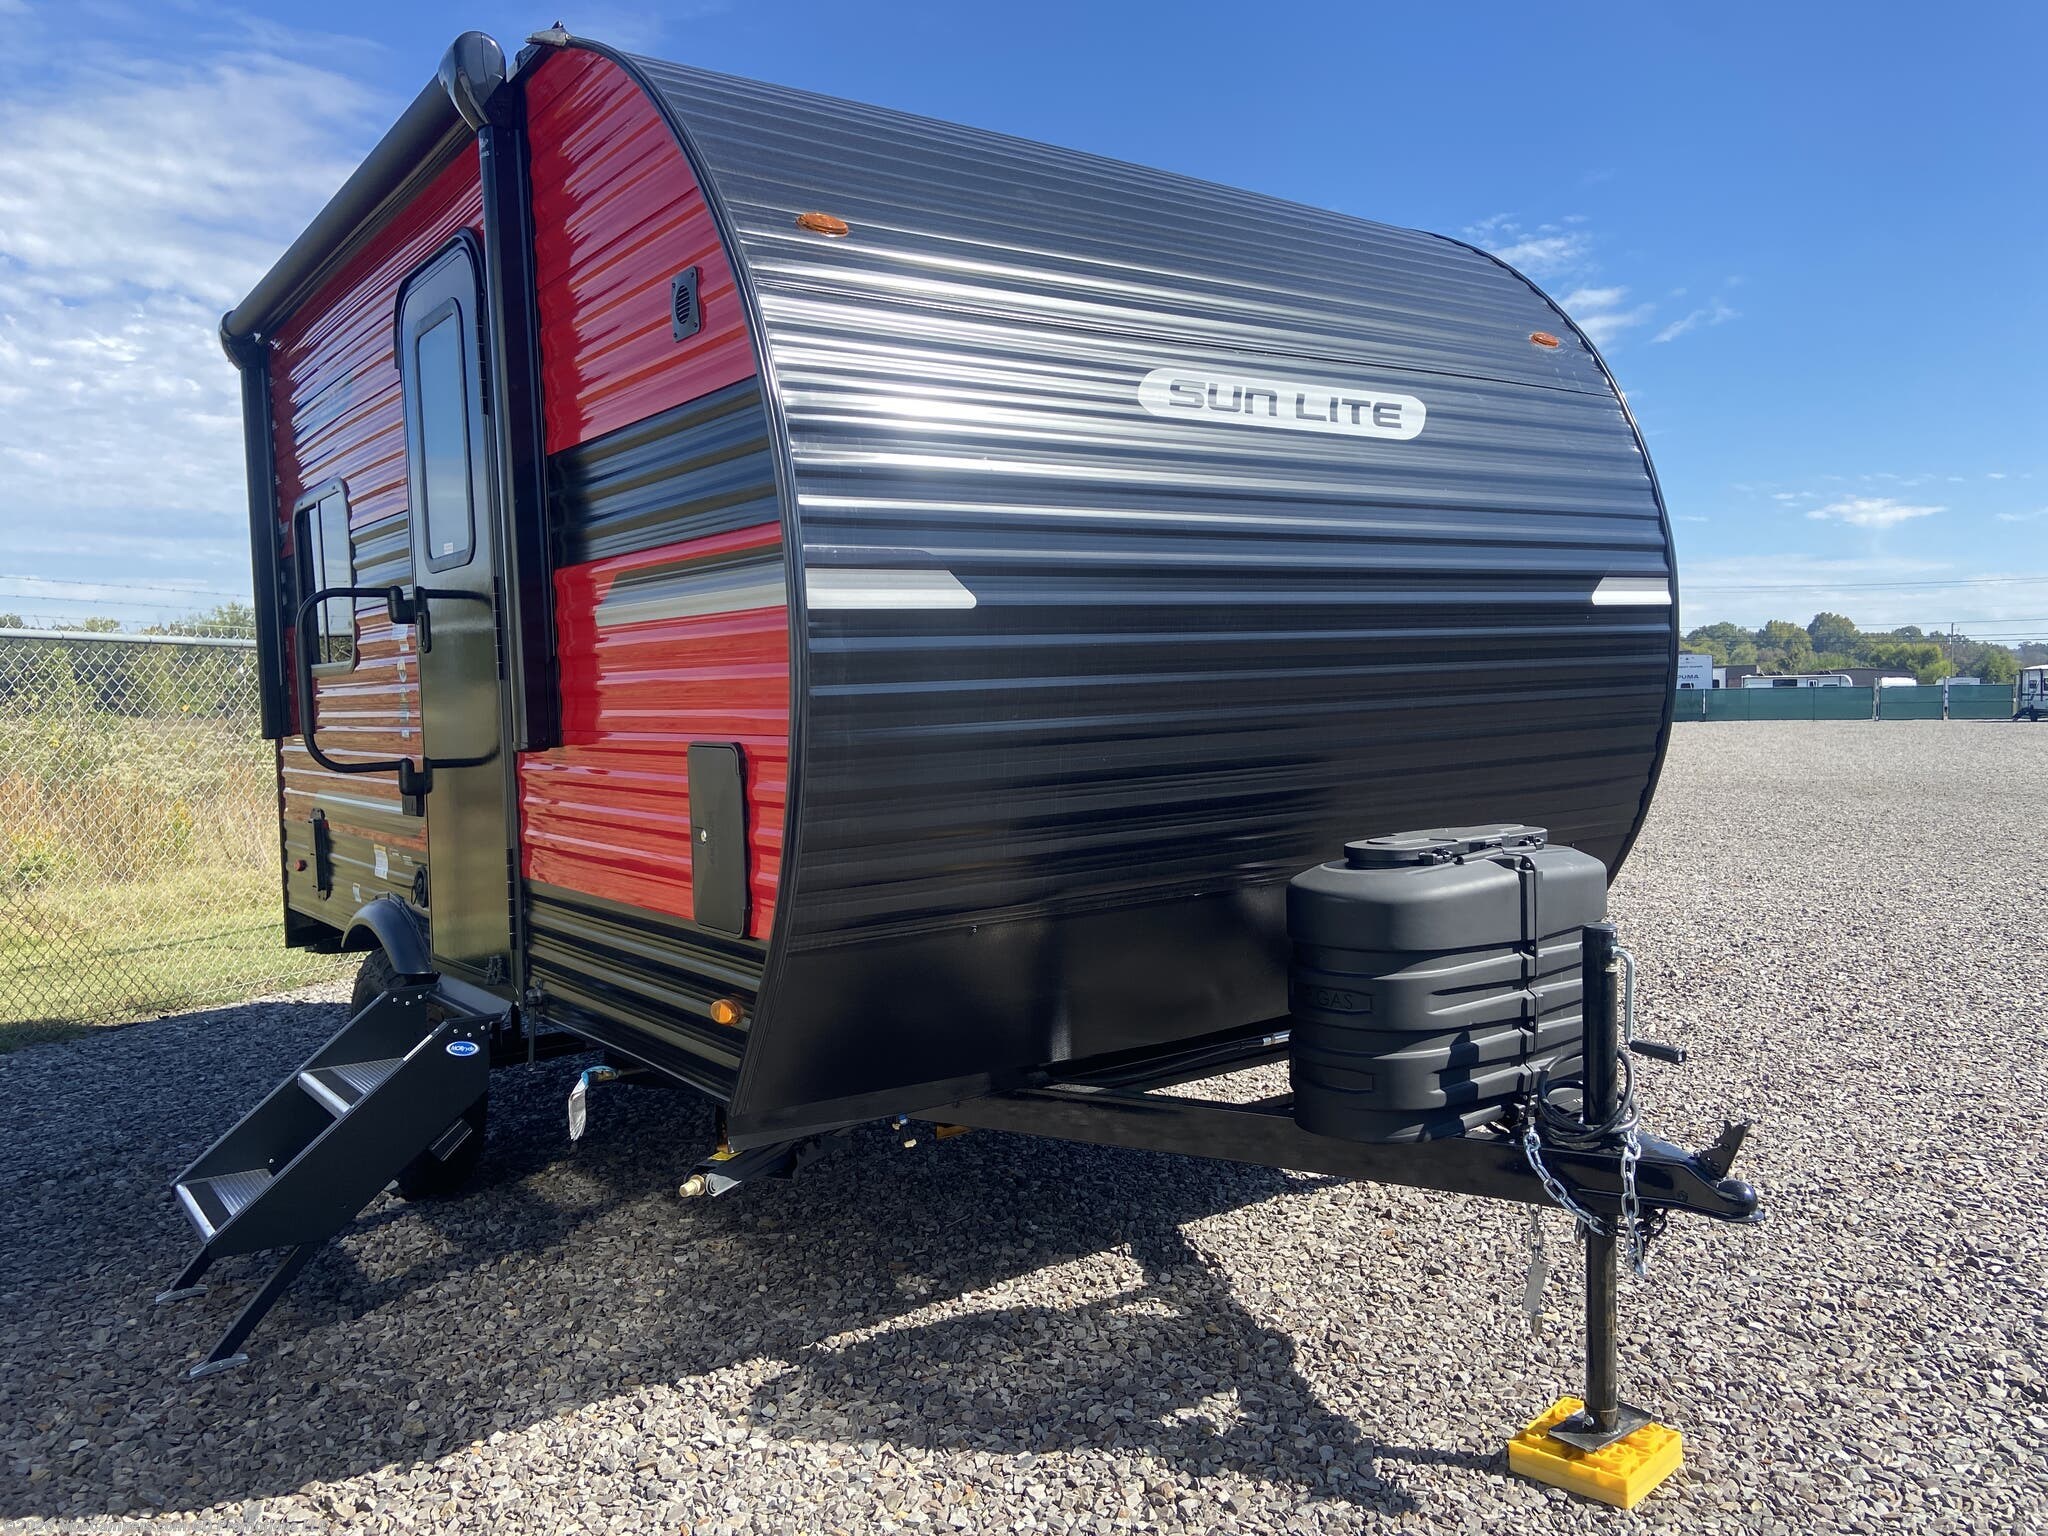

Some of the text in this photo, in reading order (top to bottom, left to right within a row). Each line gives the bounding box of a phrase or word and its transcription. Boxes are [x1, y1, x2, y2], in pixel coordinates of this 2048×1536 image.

[1169, 379, 1403, 429] SUN LITE
[1319, 990, 1353, 1010] GAS
